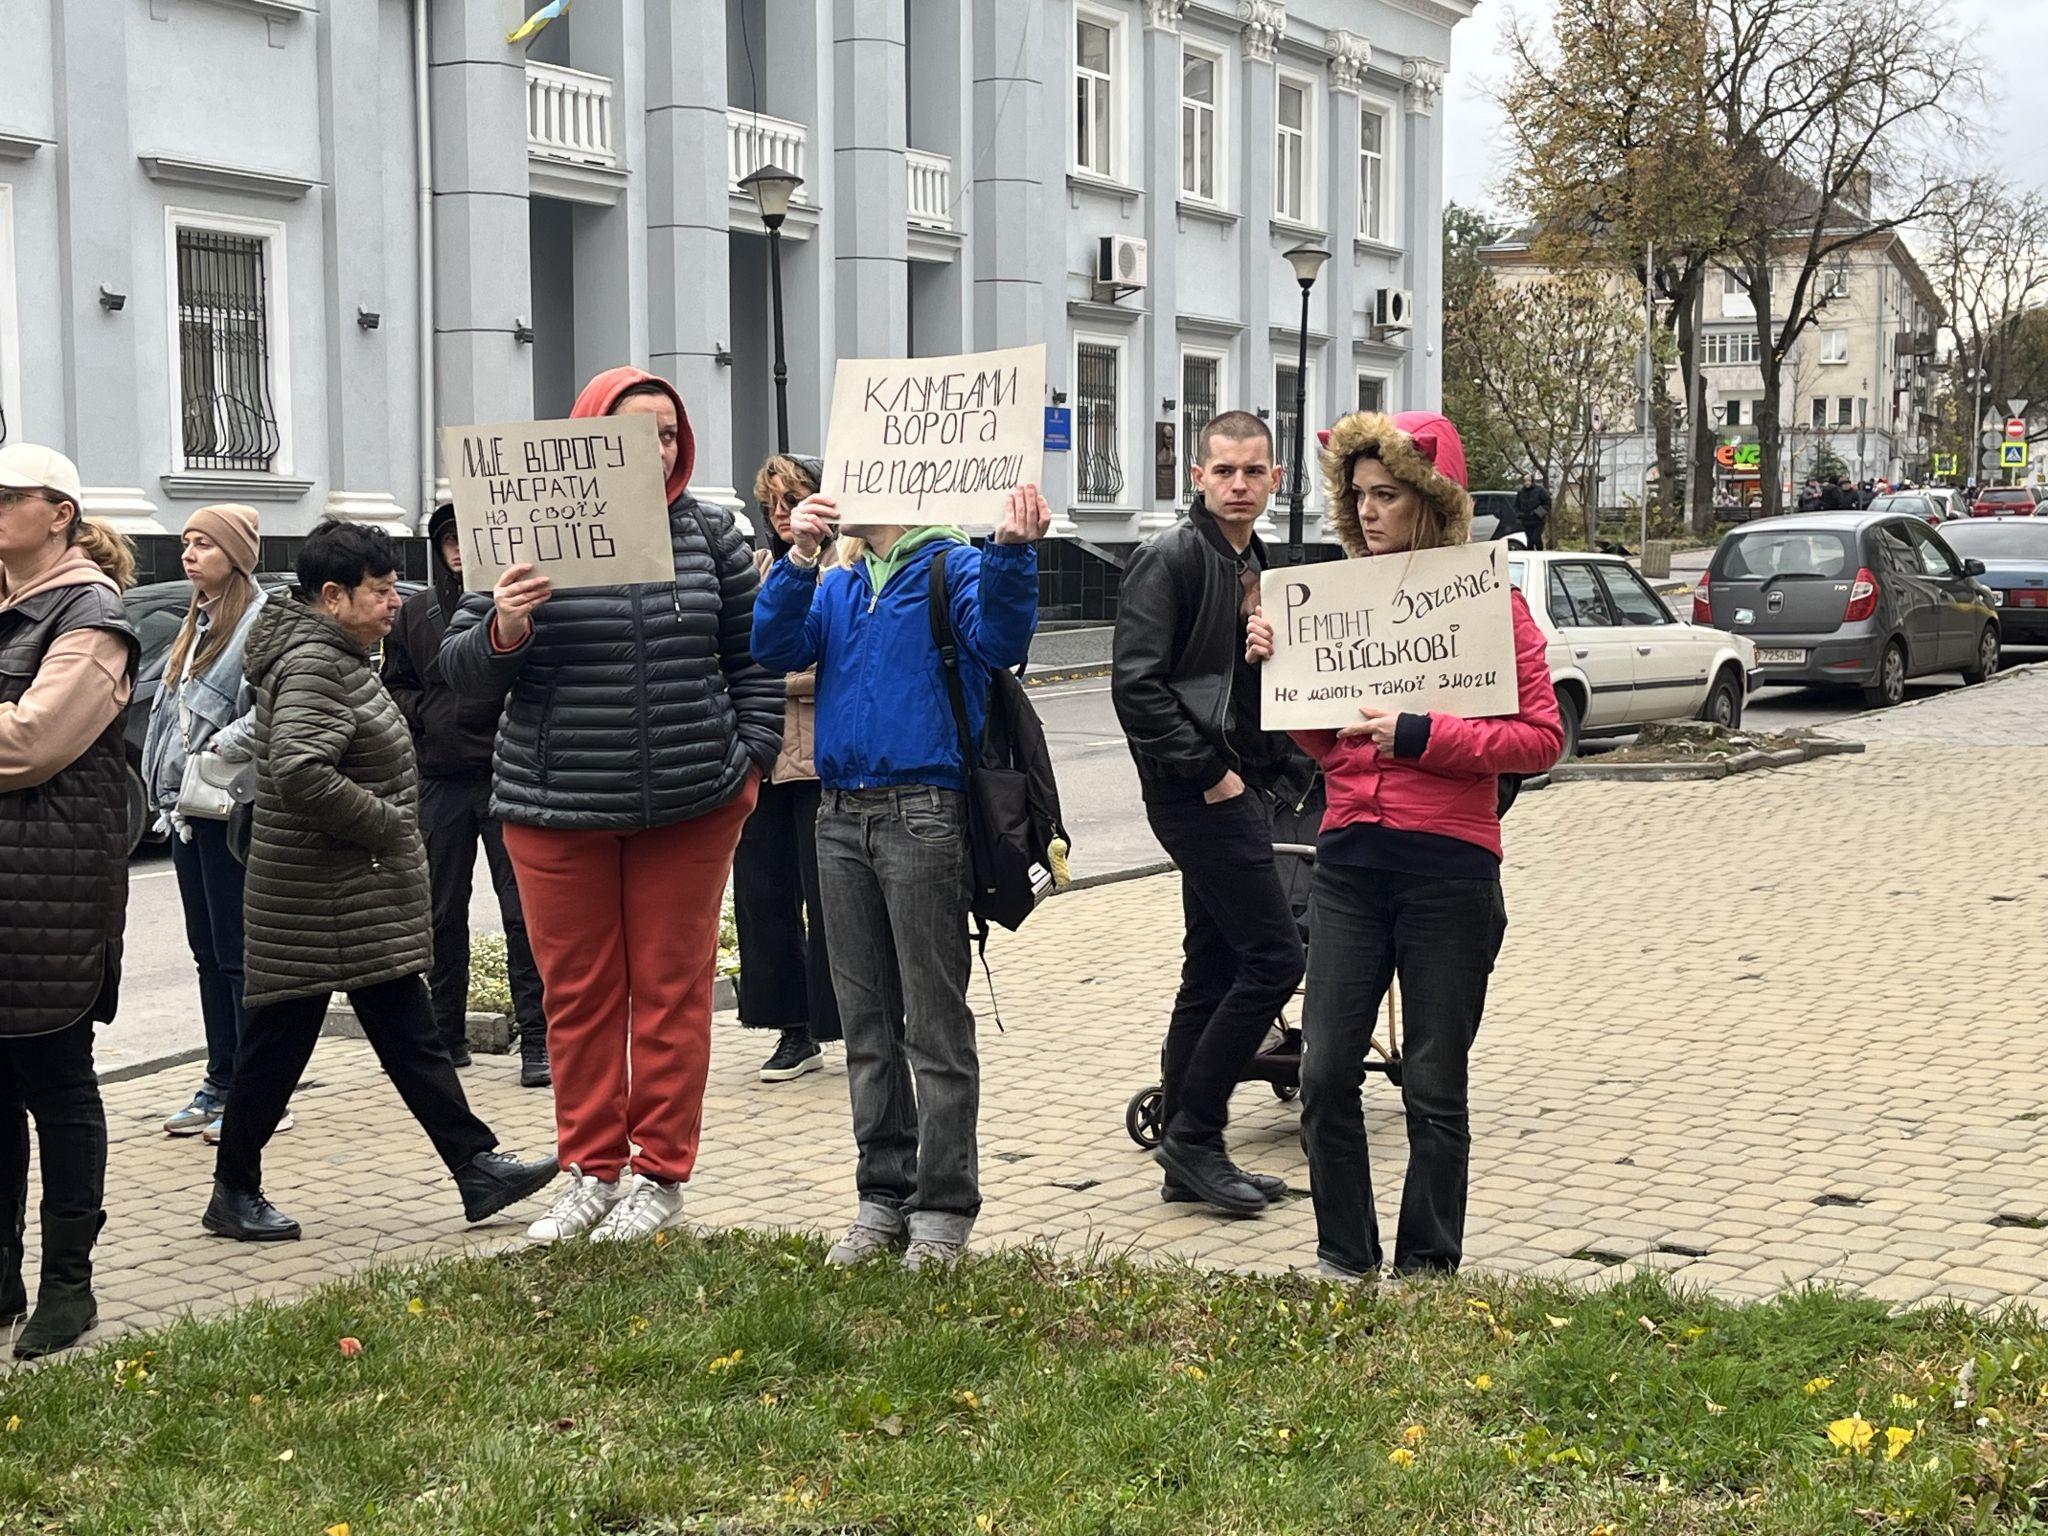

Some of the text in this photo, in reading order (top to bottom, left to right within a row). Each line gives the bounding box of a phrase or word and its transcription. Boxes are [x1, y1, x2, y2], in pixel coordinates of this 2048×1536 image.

[864, 367, 1018, 412] КЛУМБАМИ
[524, 435, 626, 473] ВОРОГУ
[489, 475, 600, 505] НАСРАТИ
[485, 501, 609, 525] на своїх
[472, 522, 617, 566] ГЕРОЇВ
[1307, 684, 1363, 702] мають
[1368, 674, 1426, 696] такої
